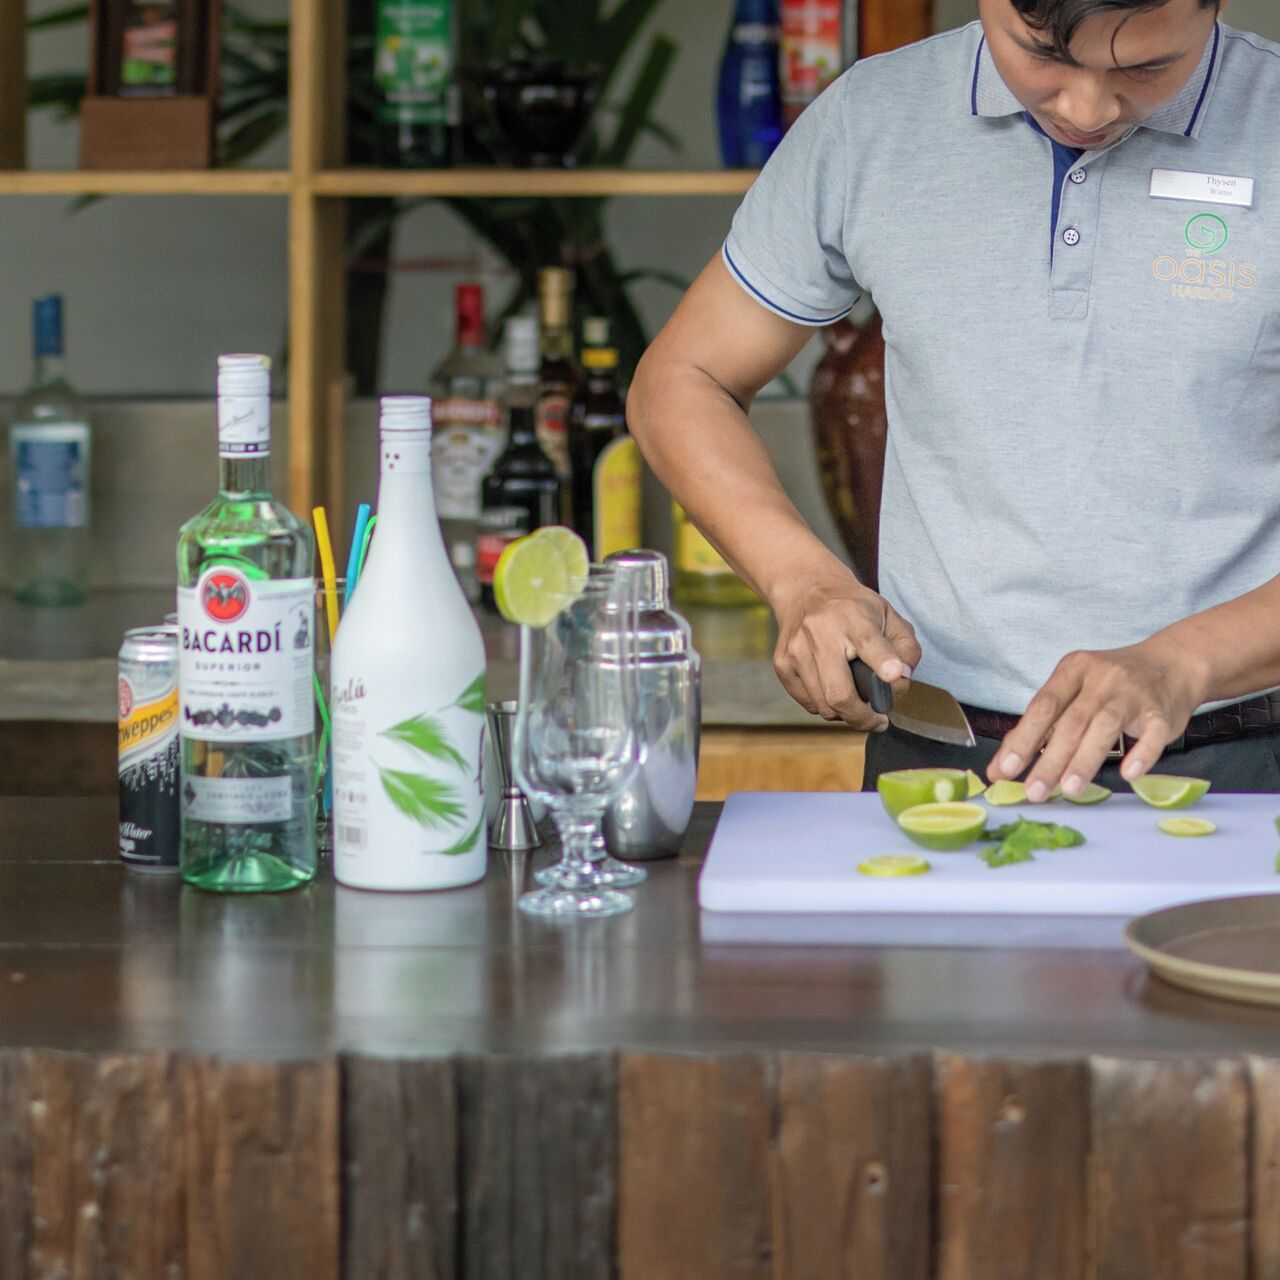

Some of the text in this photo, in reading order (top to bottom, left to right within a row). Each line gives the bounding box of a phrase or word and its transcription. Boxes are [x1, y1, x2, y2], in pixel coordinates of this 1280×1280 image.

[1152, 253, 1257, 289] oasis
[183, 621, 282, 654] BACARDÍ
[194, 661, 262, 671] SUPERIOR
[119, 705, 174, 742] weppes
